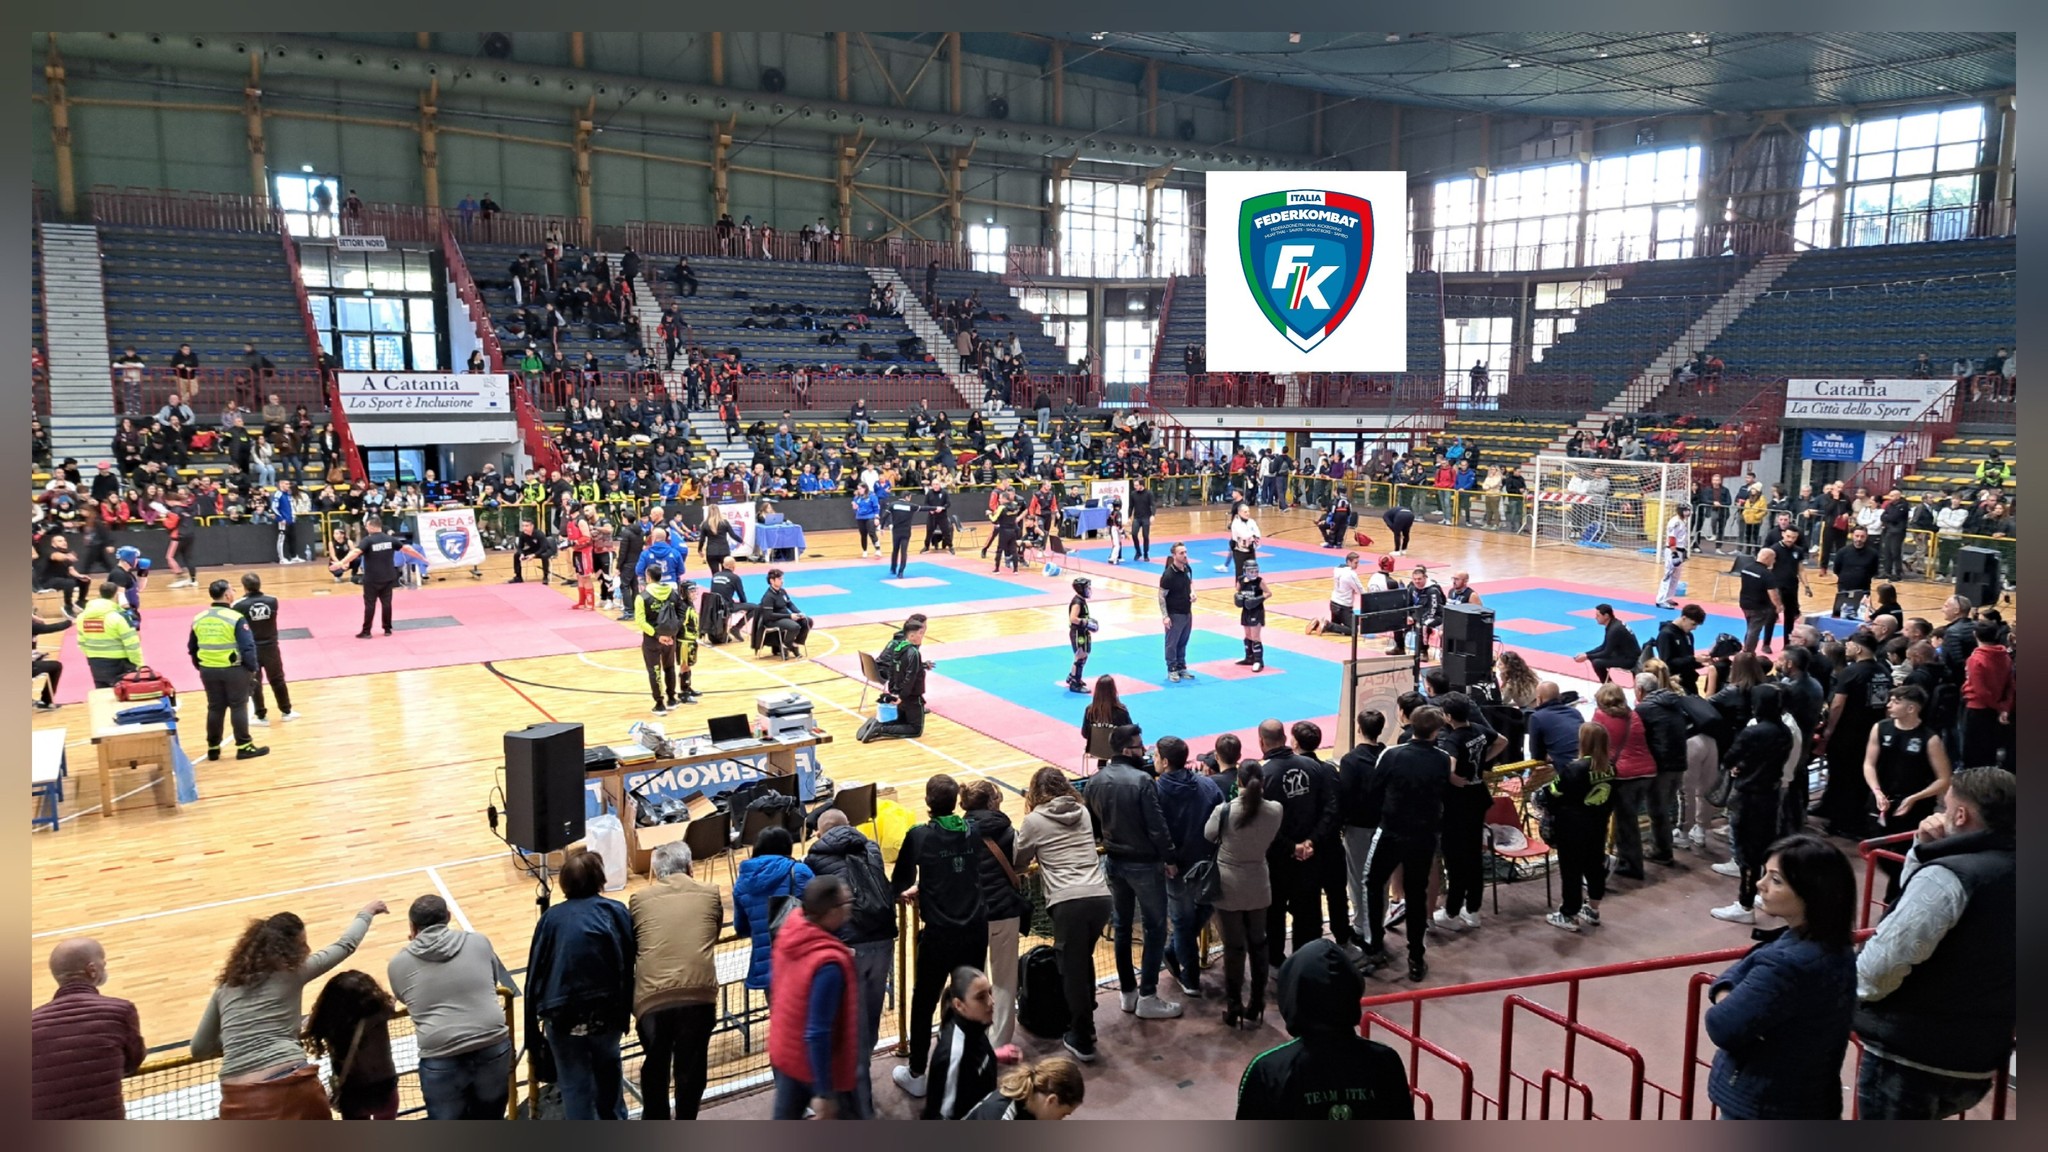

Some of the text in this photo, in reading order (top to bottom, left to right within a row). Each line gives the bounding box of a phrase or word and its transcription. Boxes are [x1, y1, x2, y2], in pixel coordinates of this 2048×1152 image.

[339, 238, 385, 247] SETTORE NORD
[361, 375, 460, 391] A Catania
[1815, 380, 1888, 397] Catania
[349, 397, 366, 409] Lo
[368, 397, 403, 412] Sport
[405, 397, 412, 409] è
[414, 396, 474, 409] Inclusione
[1791, 402, 1912, 420] La Città dello Sport
[1811, 440, 1854, 449] SATURNIA
[429, 516, 475, 528] AREA 5
